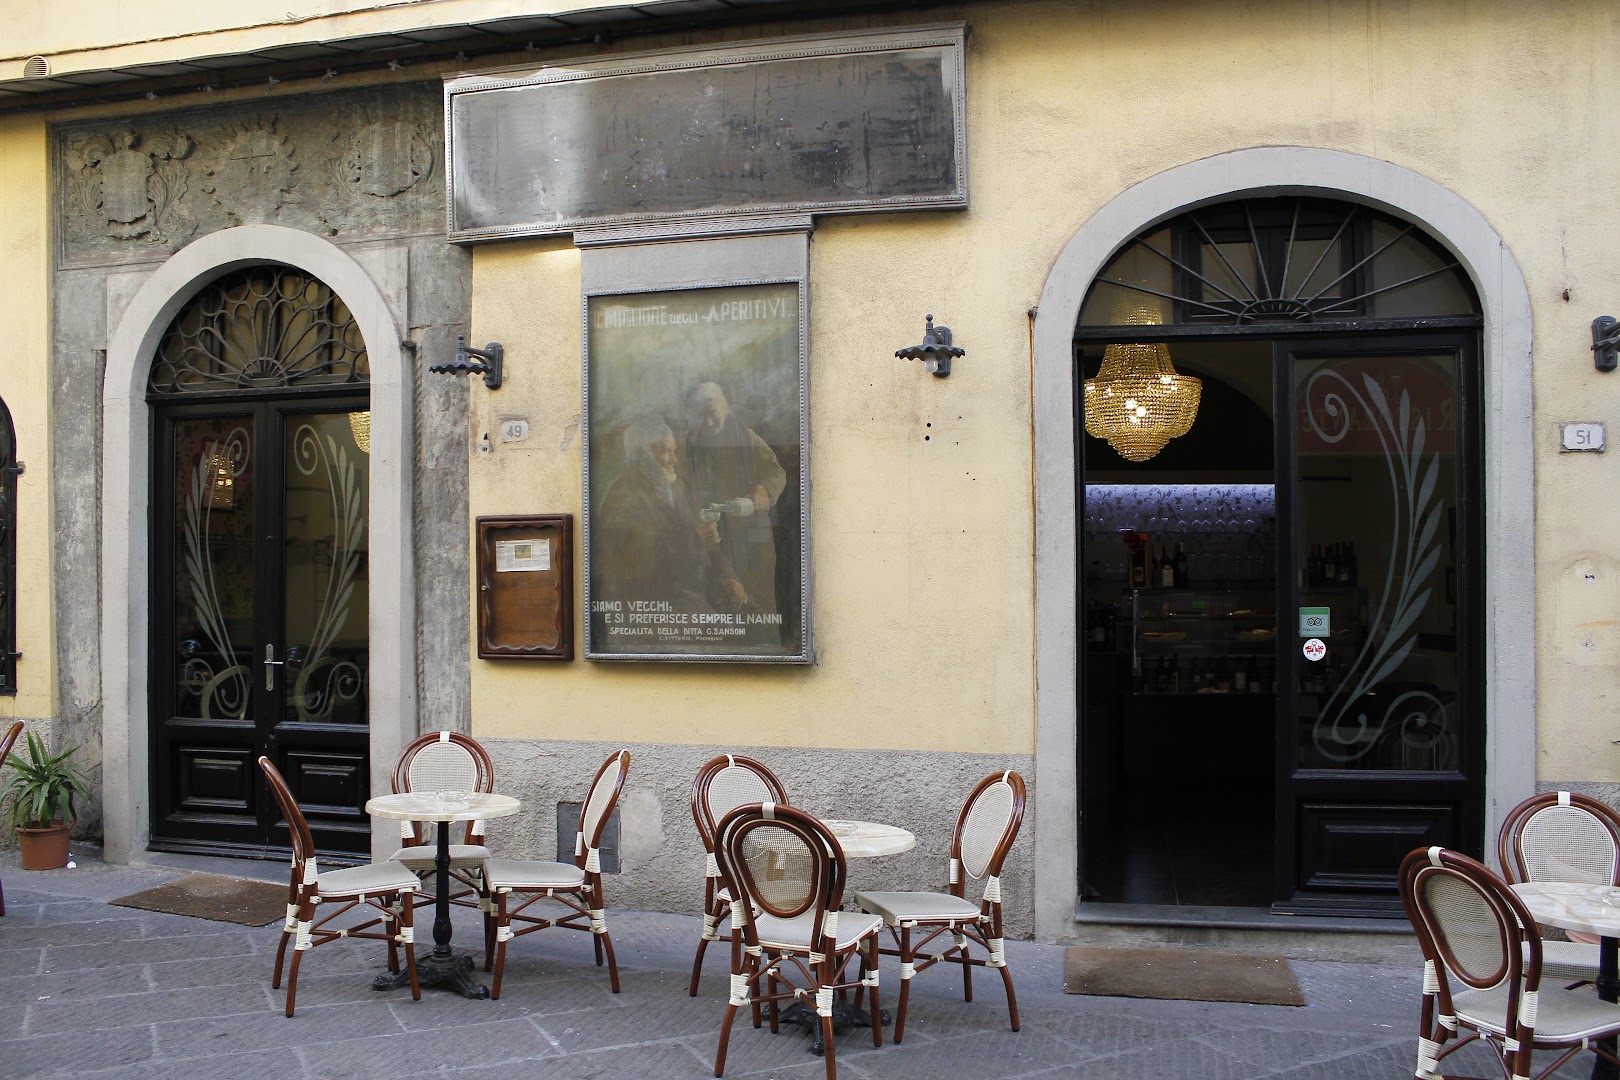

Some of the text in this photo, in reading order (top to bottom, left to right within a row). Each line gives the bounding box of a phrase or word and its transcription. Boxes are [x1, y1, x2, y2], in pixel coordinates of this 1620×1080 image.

[669, 313, 698, 324] DEGLI
[506, 424, 522, 438] 49
[1576, 430, 1591, 445] 51
[592, 601, 622, 612] SIAMO
[604, 613, 783, 625] E SI PREFERISCE SEMPRE IL NANNI
[609, 627, 654, 636] SPECIALITA
[657, 627, 680, 636] DELLA
[683, 627, 703, 636] DITTA
